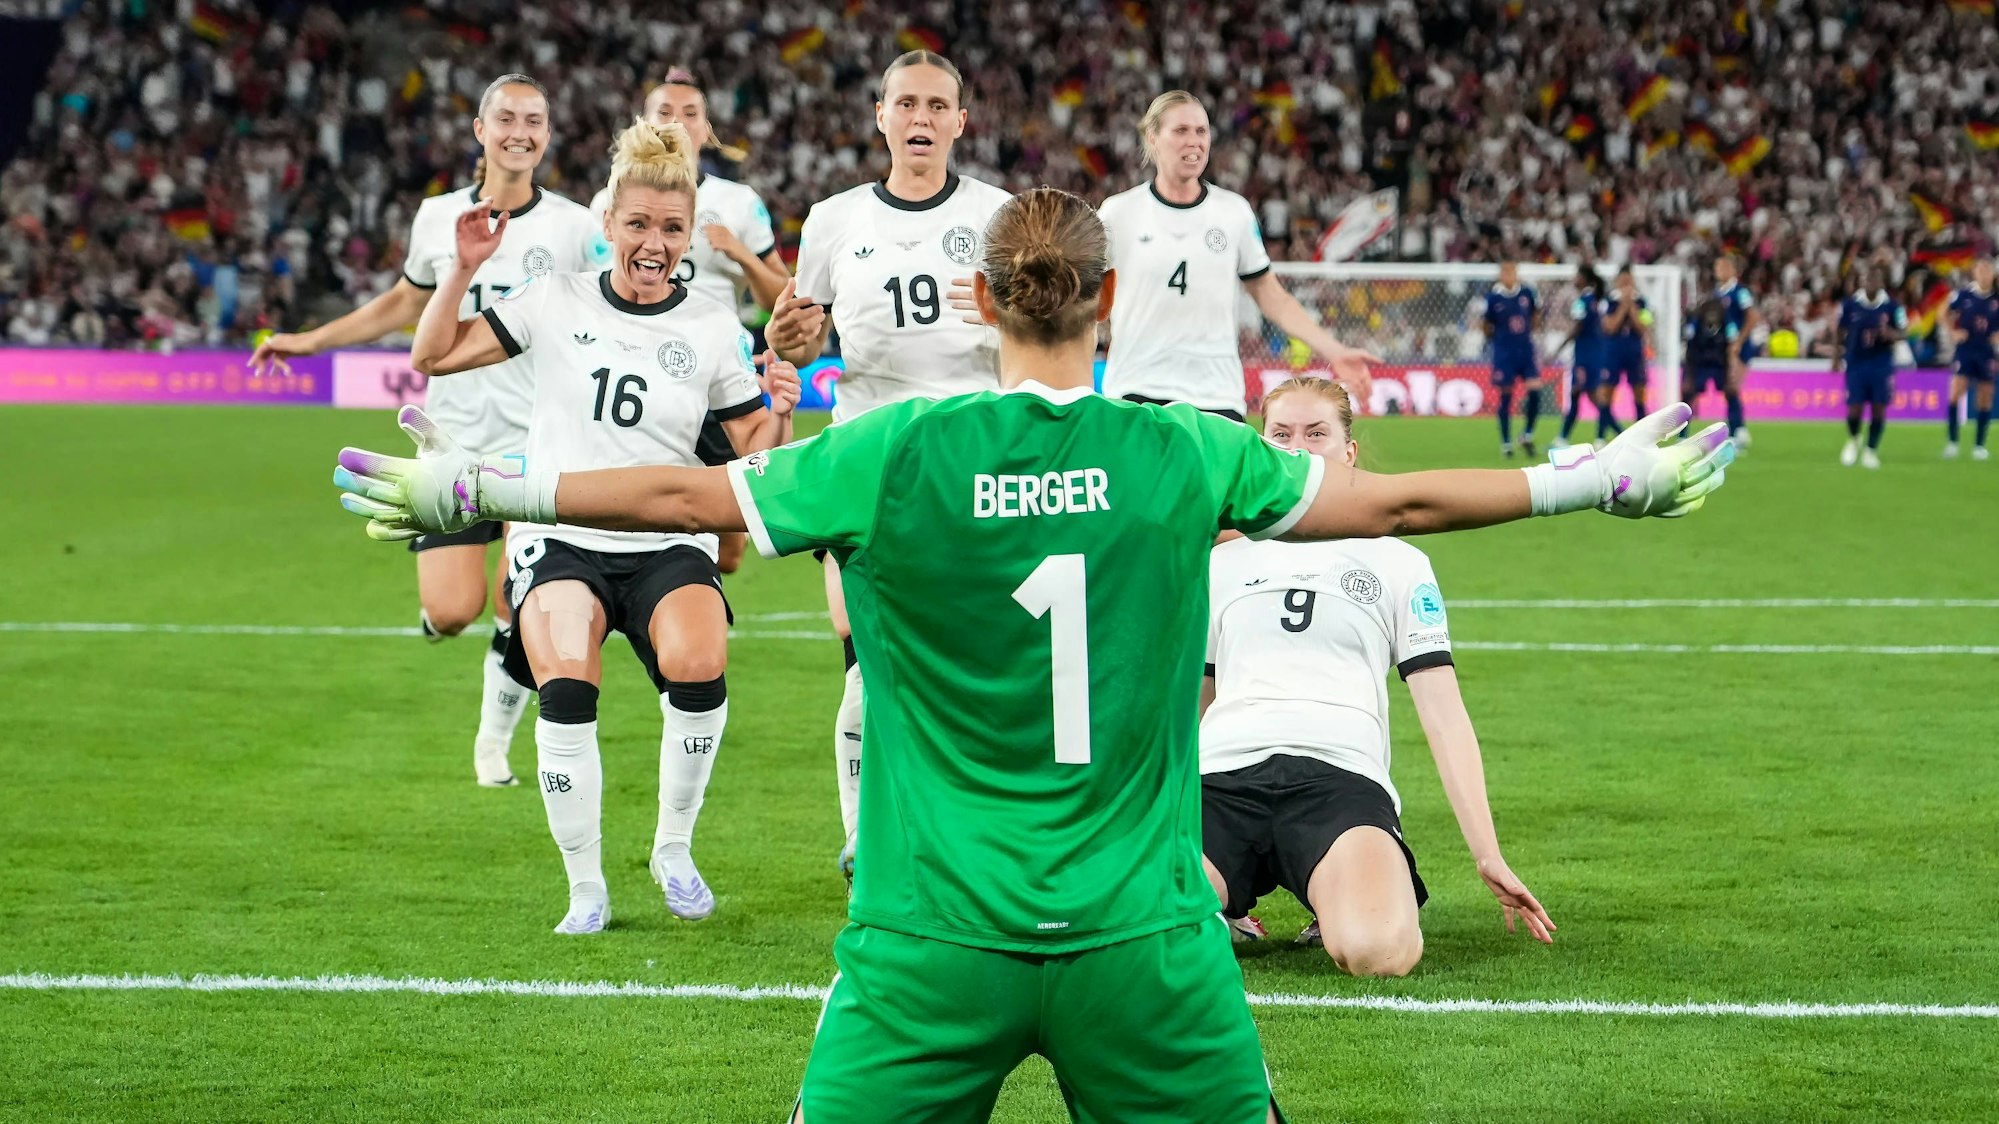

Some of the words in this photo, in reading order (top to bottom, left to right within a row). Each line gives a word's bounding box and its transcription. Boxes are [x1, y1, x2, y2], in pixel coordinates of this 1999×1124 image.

[883, 274, 941, 328] 19
[1168, 260, 1187, 295] 4
[590, 367, 648, 428] 16
[1892, 389, 1940, 411] UTE
[973, 468, 1111, 518] BERGER
[1280, 589, 1316, 632] 9
[1011, 553, 1091, 764] 1
